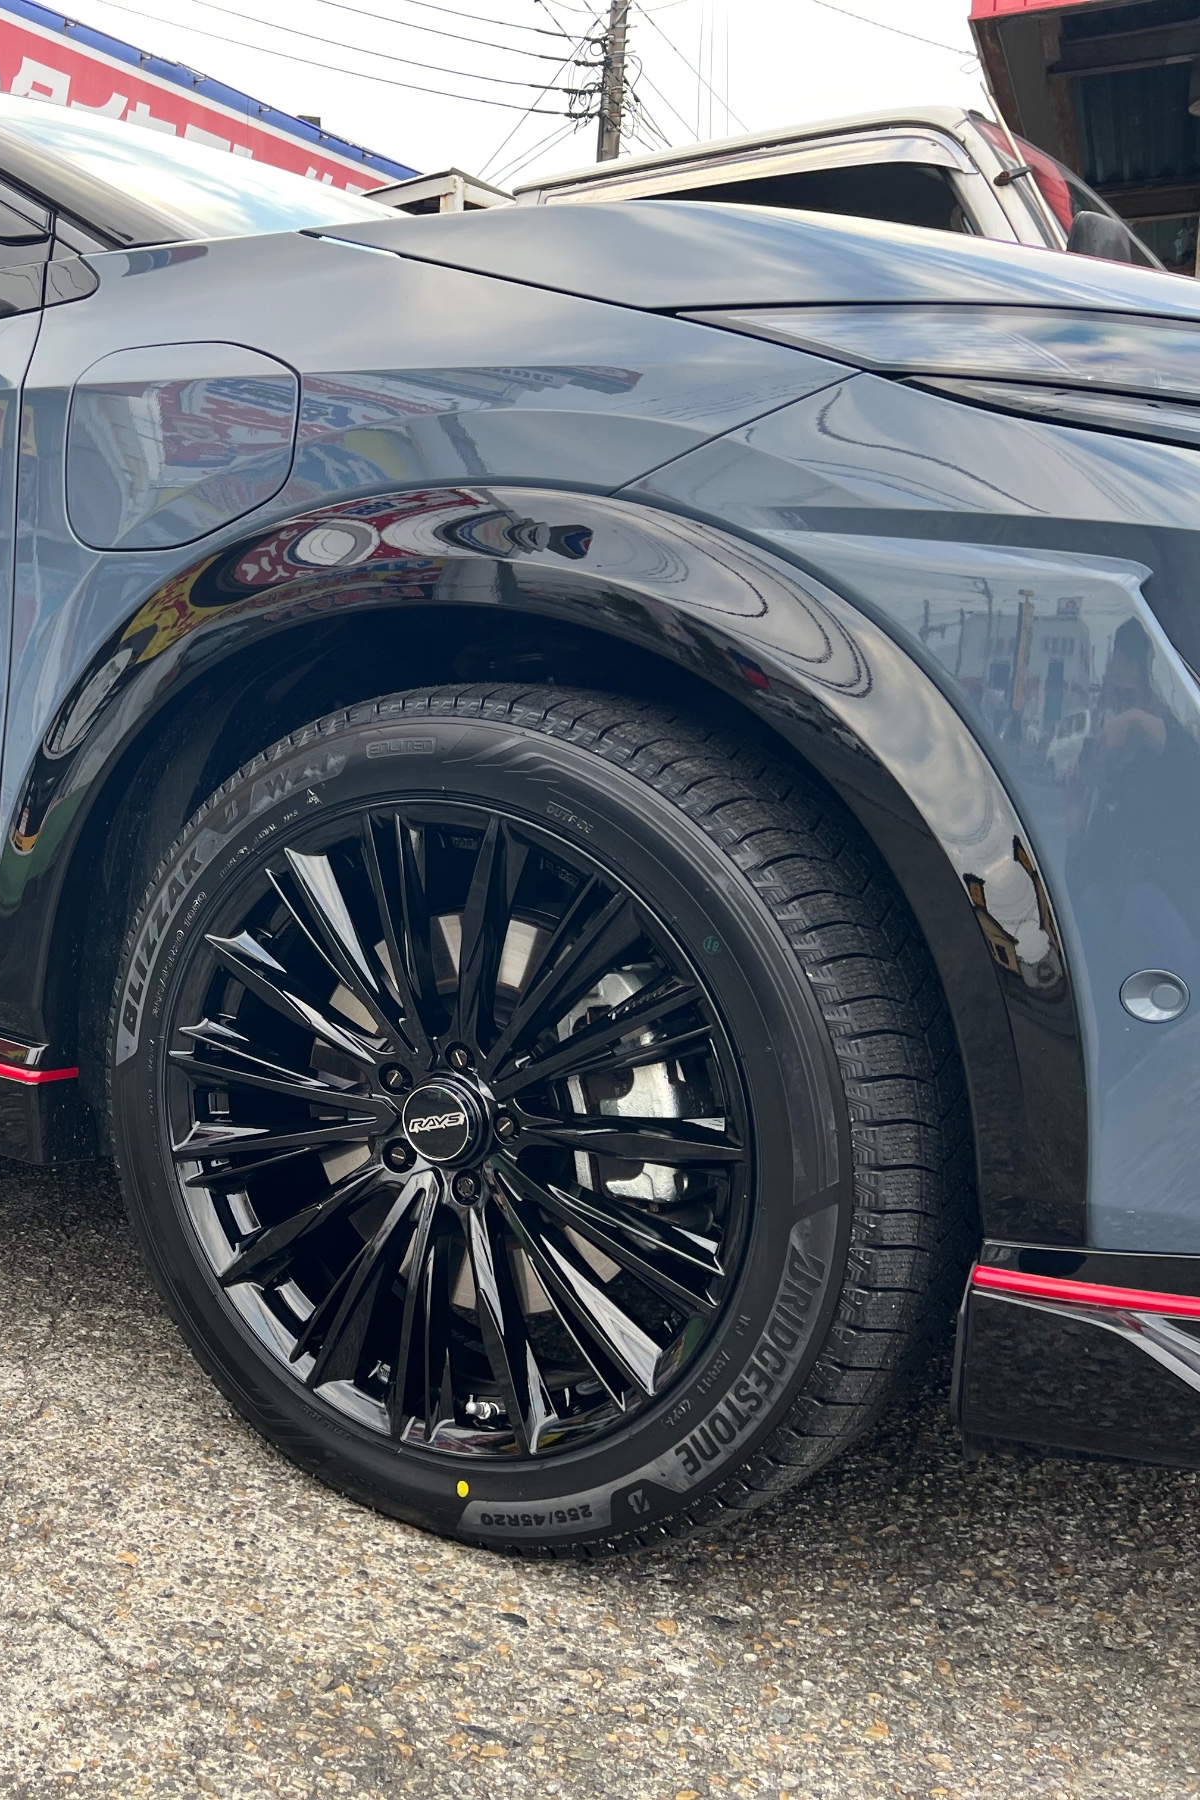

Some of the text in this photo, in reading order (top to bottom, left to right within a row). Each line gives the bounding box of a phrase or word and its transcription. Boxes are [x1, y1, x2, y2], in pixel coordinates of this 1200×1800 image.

[123, 845, 204, 1038] BLIZZAK
[409, 1112, 466, 1134] RAYS
[675, 1247, 827, 1478] BRIDGESTONE
[479, 1504, 594, 1529] 255/45R20
